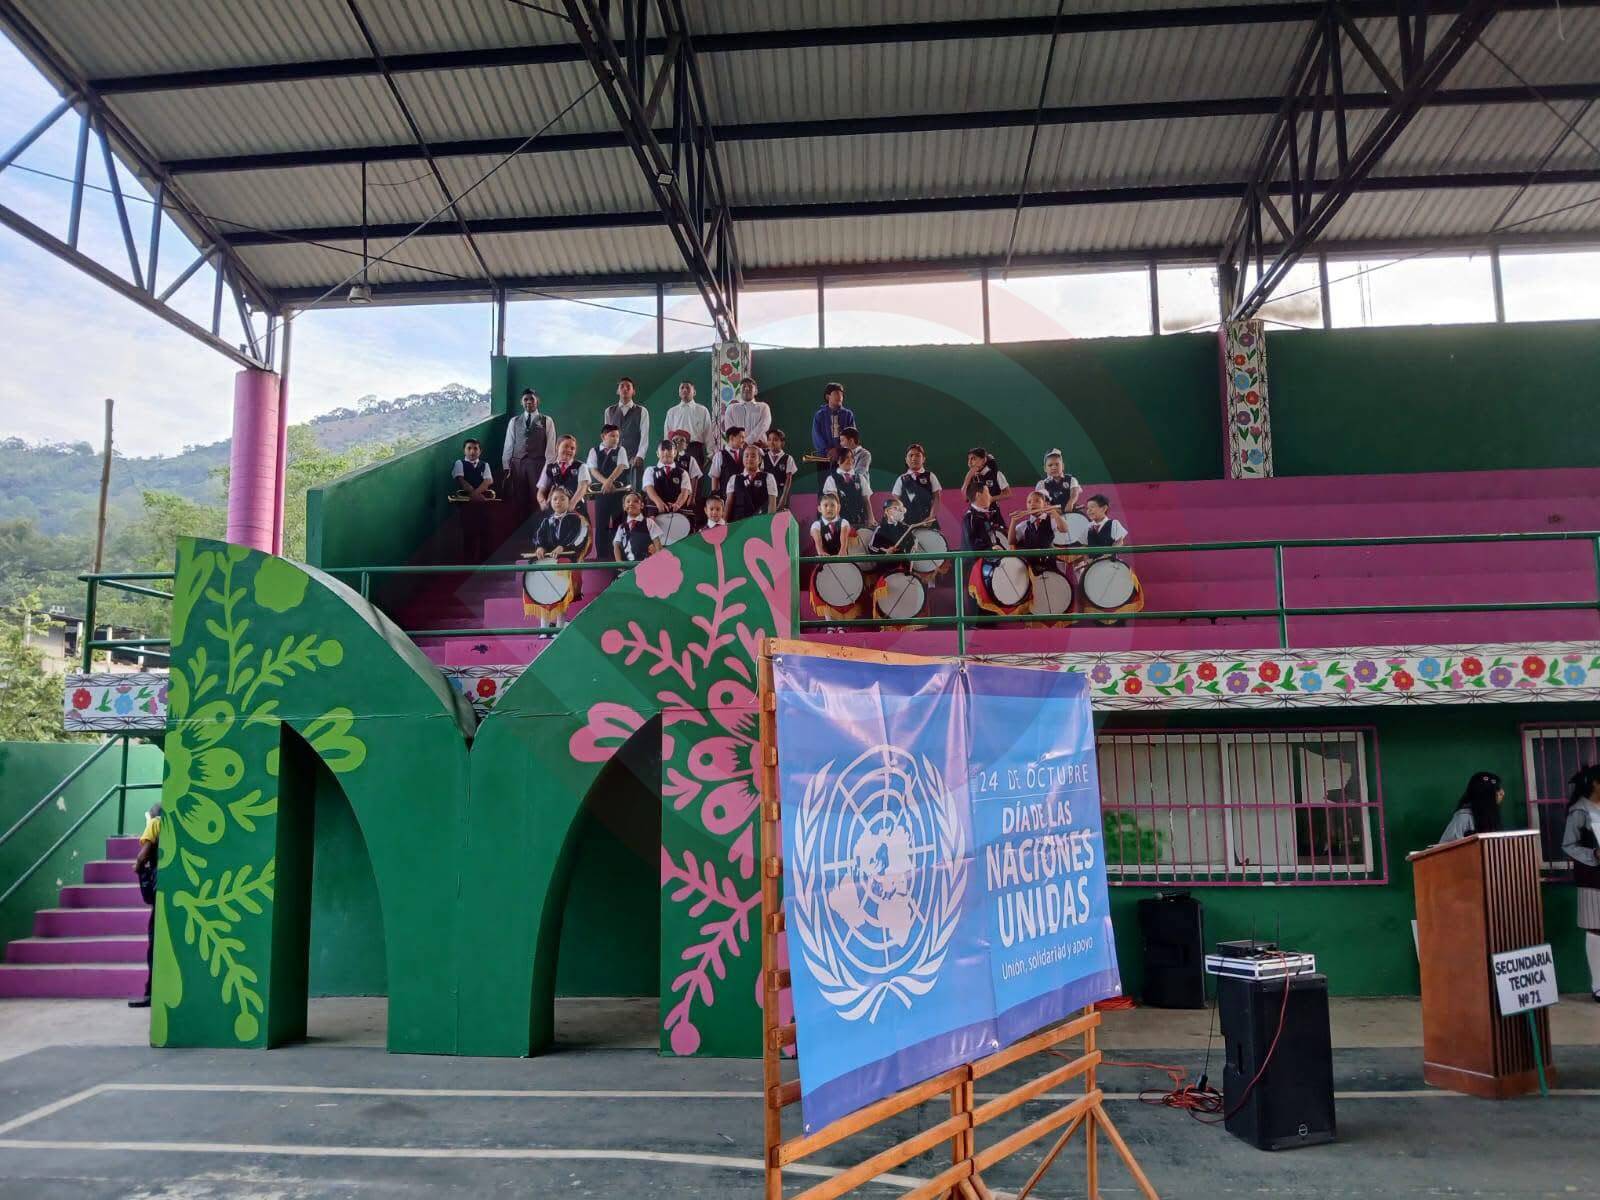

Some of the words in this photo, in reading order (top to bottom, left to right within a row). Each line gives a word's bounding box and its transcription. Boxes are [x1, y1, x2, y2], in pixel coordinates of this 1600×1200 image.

[980, 771, 998, 792] 24
[1008, 769, 1021, 790] DE
[1027, 764, 1089, 788] OCTUBRE
[1002, 801, 1030, 834] DÍA
[1030, 803, 1047, 831] DE
[1047, 800, 1072, 828] LAS
[986, 829, 1094, 891] NACIONES
[998, 876, 1090, 948] UNIDAS
[1028, 940, 1066, 971] solidariad
[1072, 937, 1093, 956] apoyo
[1495, 951, 1552, 976] SECUNDARIA
[1508, 970, 1547, 991] TECNICA
